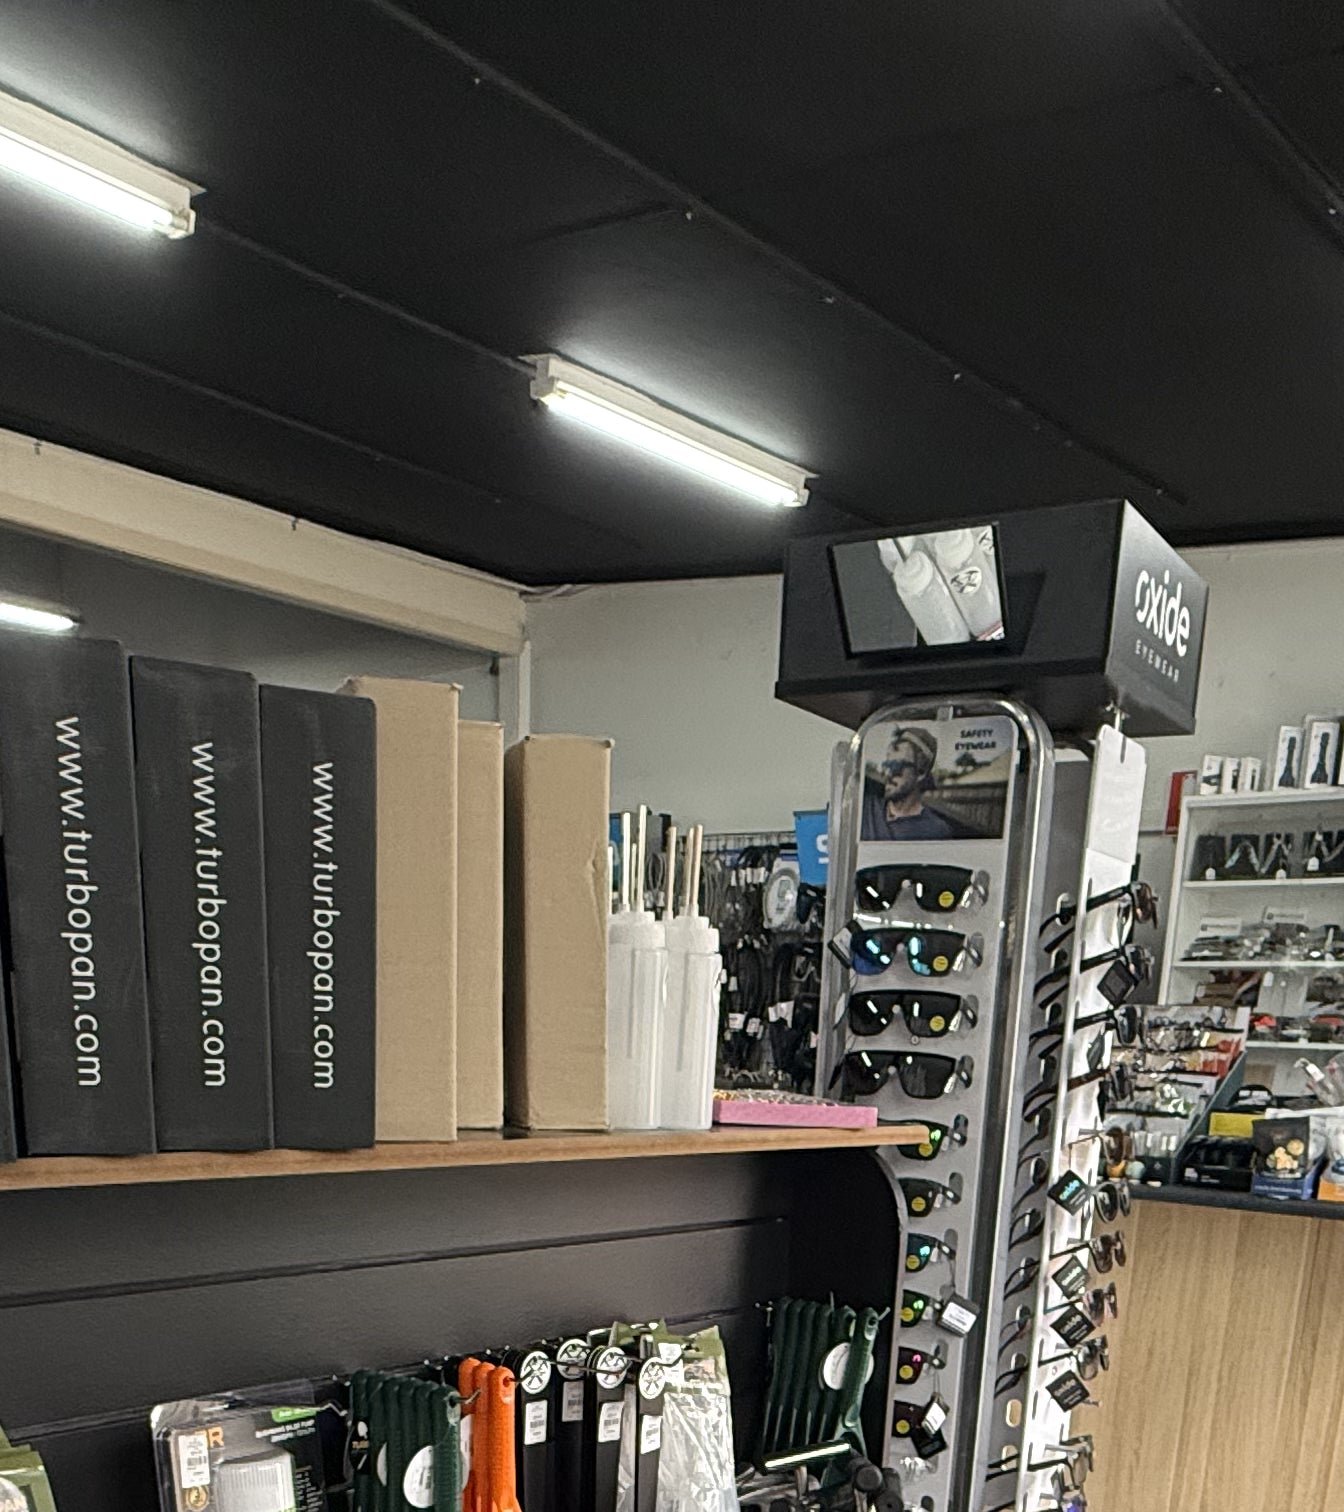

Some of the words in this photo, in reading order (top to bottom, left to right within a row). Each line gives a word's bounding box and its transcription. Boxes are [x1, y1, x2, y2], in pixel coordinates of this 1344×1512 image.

[1135, 570, 1190, 657] oxide
[1135, 639, 1179, 682] EYEWEAR
[955, 741, 997, 751] EYEWEAR
[960, 729, 994, 738] SAFETY
[55, 716, 102, 1088] www.turbopan.com
[191, 741, 228, 1088] www.turbopan.com
[306, 762, 340, 1090] www.turbopan.com
